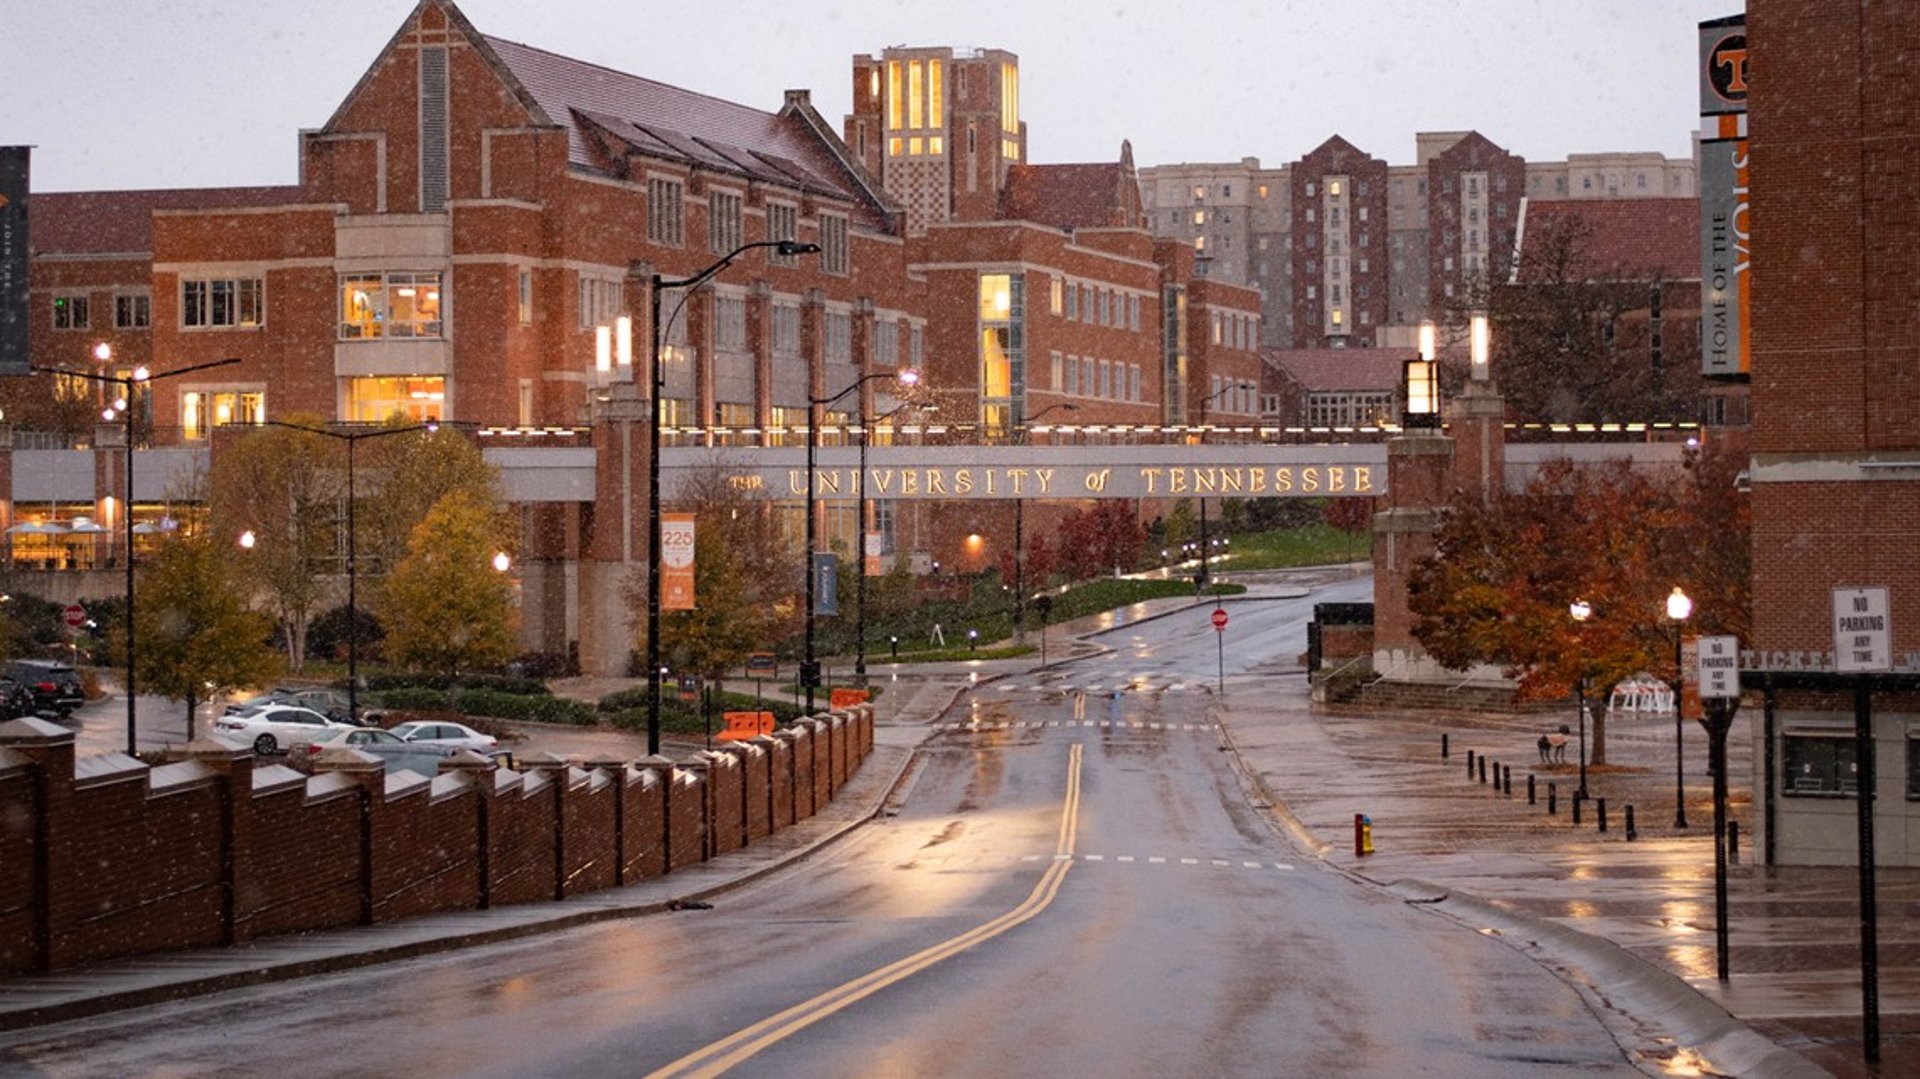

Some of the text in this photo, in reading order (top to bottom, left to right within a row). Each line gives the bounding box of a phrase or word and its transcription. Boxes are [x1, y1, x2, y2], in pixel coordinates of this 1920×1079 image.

[1712, 213, 1727, 365] HOME OF THE
[789, 469, 1054, 494] UNIVERSITY
[1085, 469, 1110, 492] of
[1141, 467, 1373, 493] TENNESSEE
[663, 531, 693, 546] 225
[1853, 597, 1868, 612] NO
[1839, 615, 1884, 632] PARKING
[1854, 636, 1870, 647] ANY
[1712, 643, 1722, 654] NO
[1702, 657, 1734, 668] PARKING
[1853, 651, 1872, 662] TIME
[1712, 671, 1724, 679] ANY
